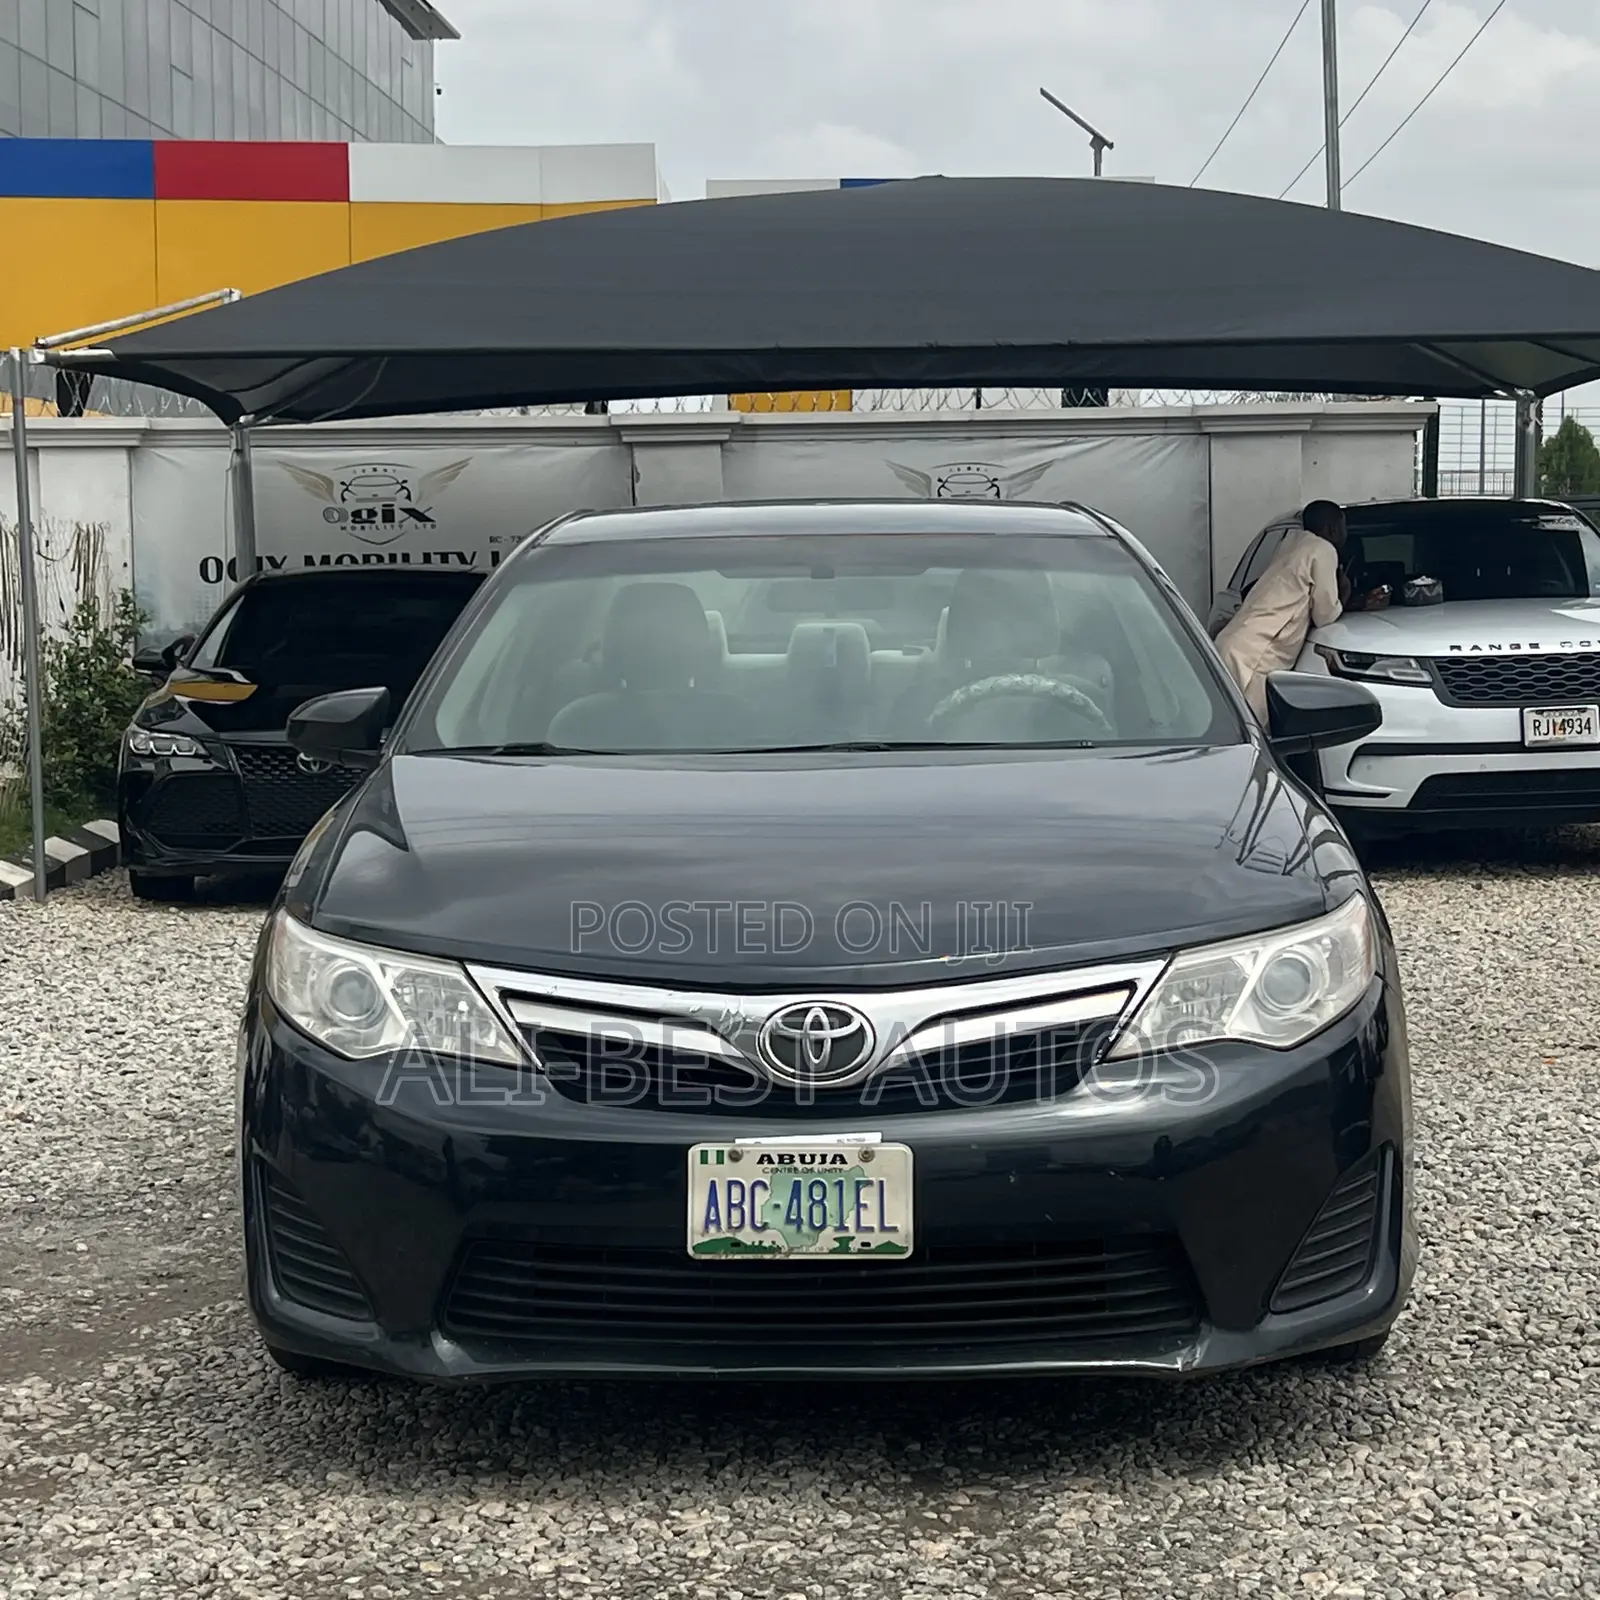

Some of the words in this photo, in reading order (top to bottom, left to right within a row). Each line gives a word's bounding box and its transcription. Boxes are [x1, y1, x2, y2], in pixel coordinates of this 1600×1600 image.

[1450, 642, 1541, 651] RANGE
[1560, 639, 1600, 648] RO
[756, 1153, 848, 1165] ABUJA
